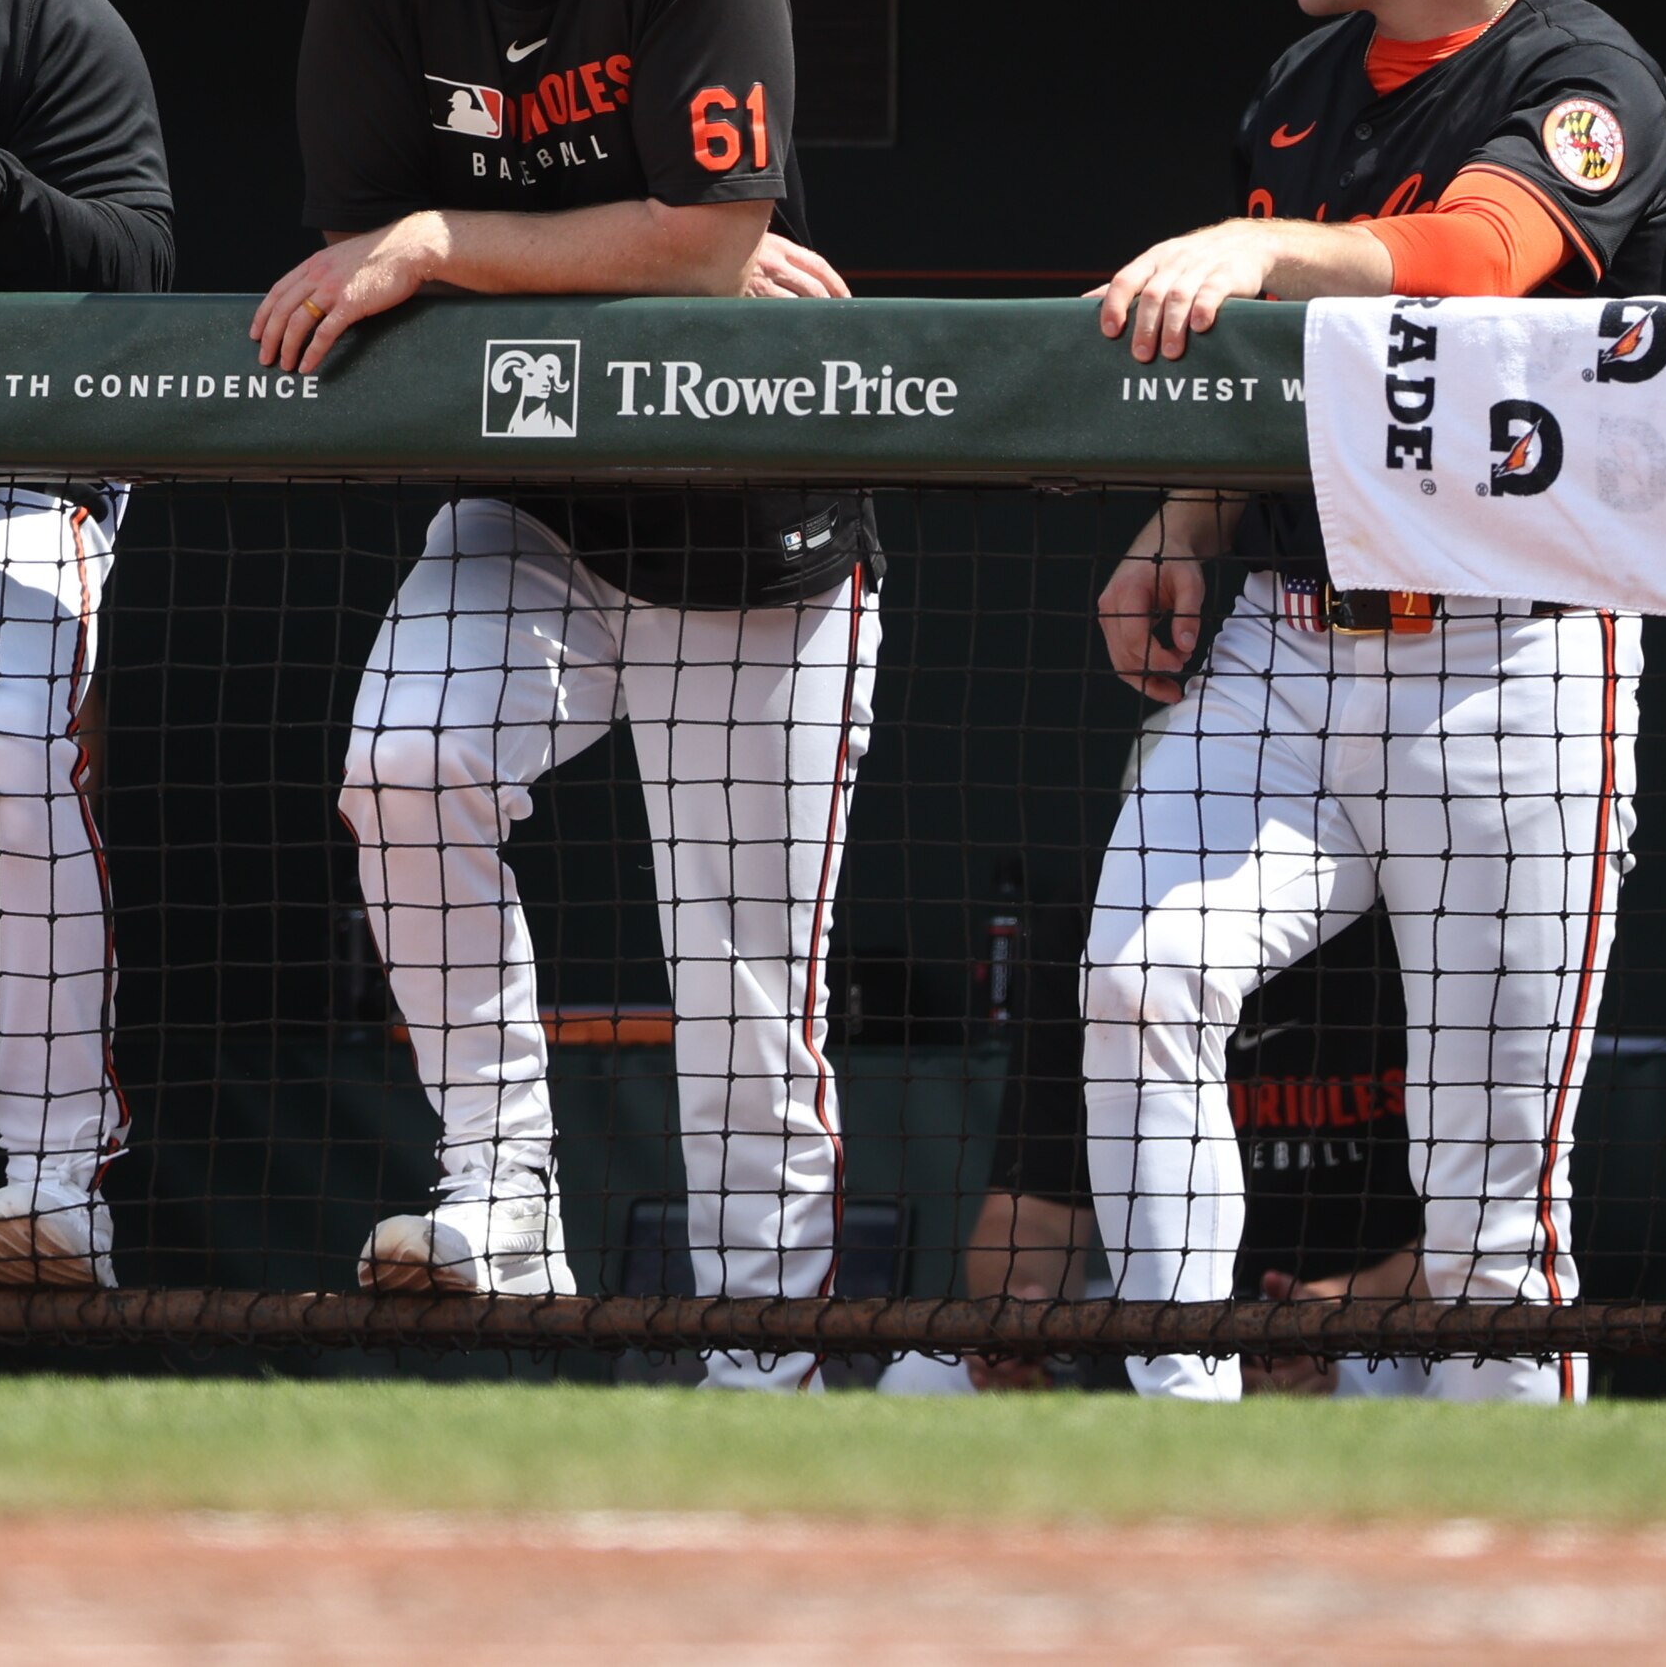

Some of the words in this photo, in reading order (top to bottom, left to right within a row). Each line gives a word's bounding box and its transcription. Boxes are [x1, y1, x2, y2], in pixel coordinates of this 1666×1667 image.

[689, 81, 770, 173] 61
[74, 373, 320, 400] CONFIDENCE
[1122, 376, 1259, 402] INVEST
